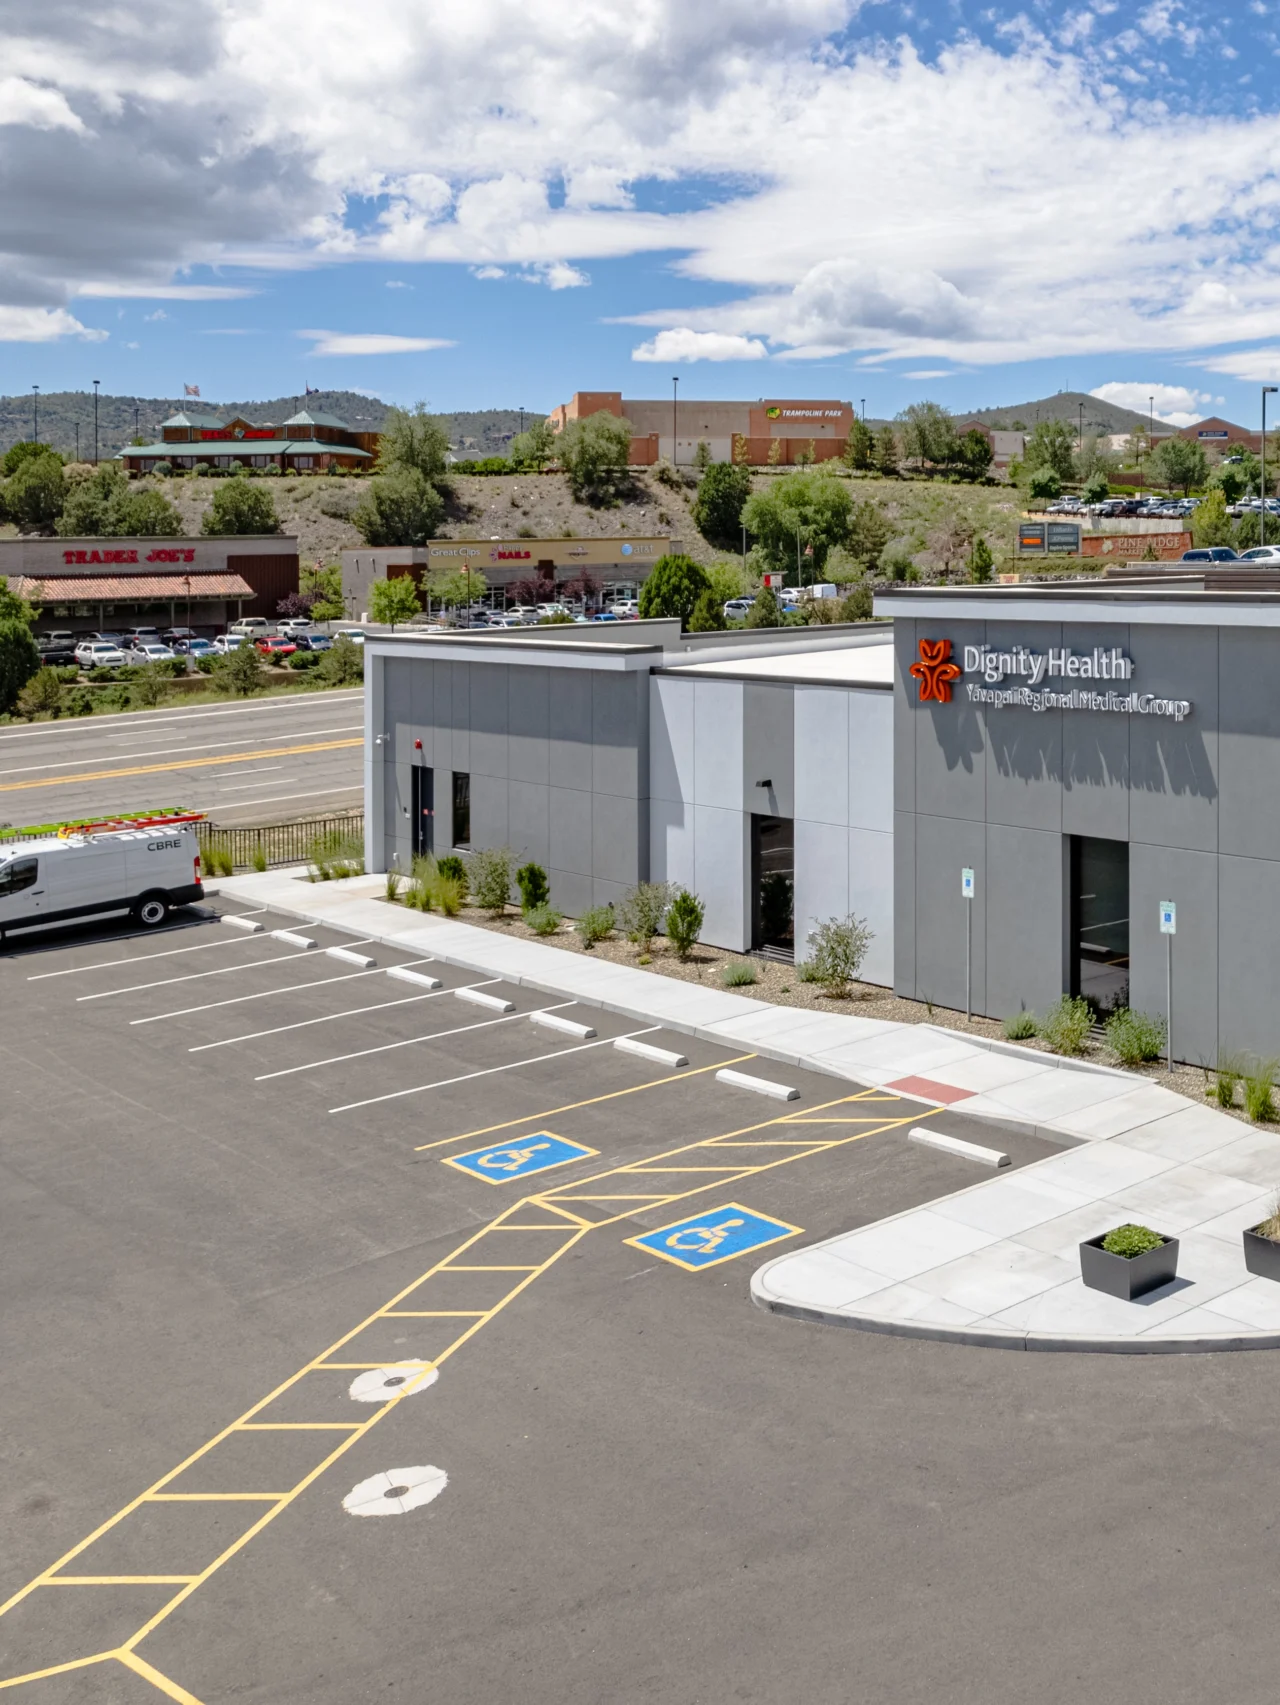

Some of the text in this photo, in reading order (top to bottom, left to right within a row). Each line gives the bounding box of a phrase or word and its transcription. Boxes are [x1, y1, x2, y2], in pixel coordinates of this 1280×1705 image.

[782, 409, 843, 417] TRAMPOLINE PARK
[1118, 537, 1180, 547] PINE RIDGE
[63, 548, 196, 565] TRADER JOE'S
[430, 547, 481, 558] Great Clips
[498, 551, 531, 559] NAILS
[964, 645, 1130, 684] Dignity Health
[966, 684, 1189, 721] Yavapai Regional Medical Group
[147, 839, 182, 851] CBRE
